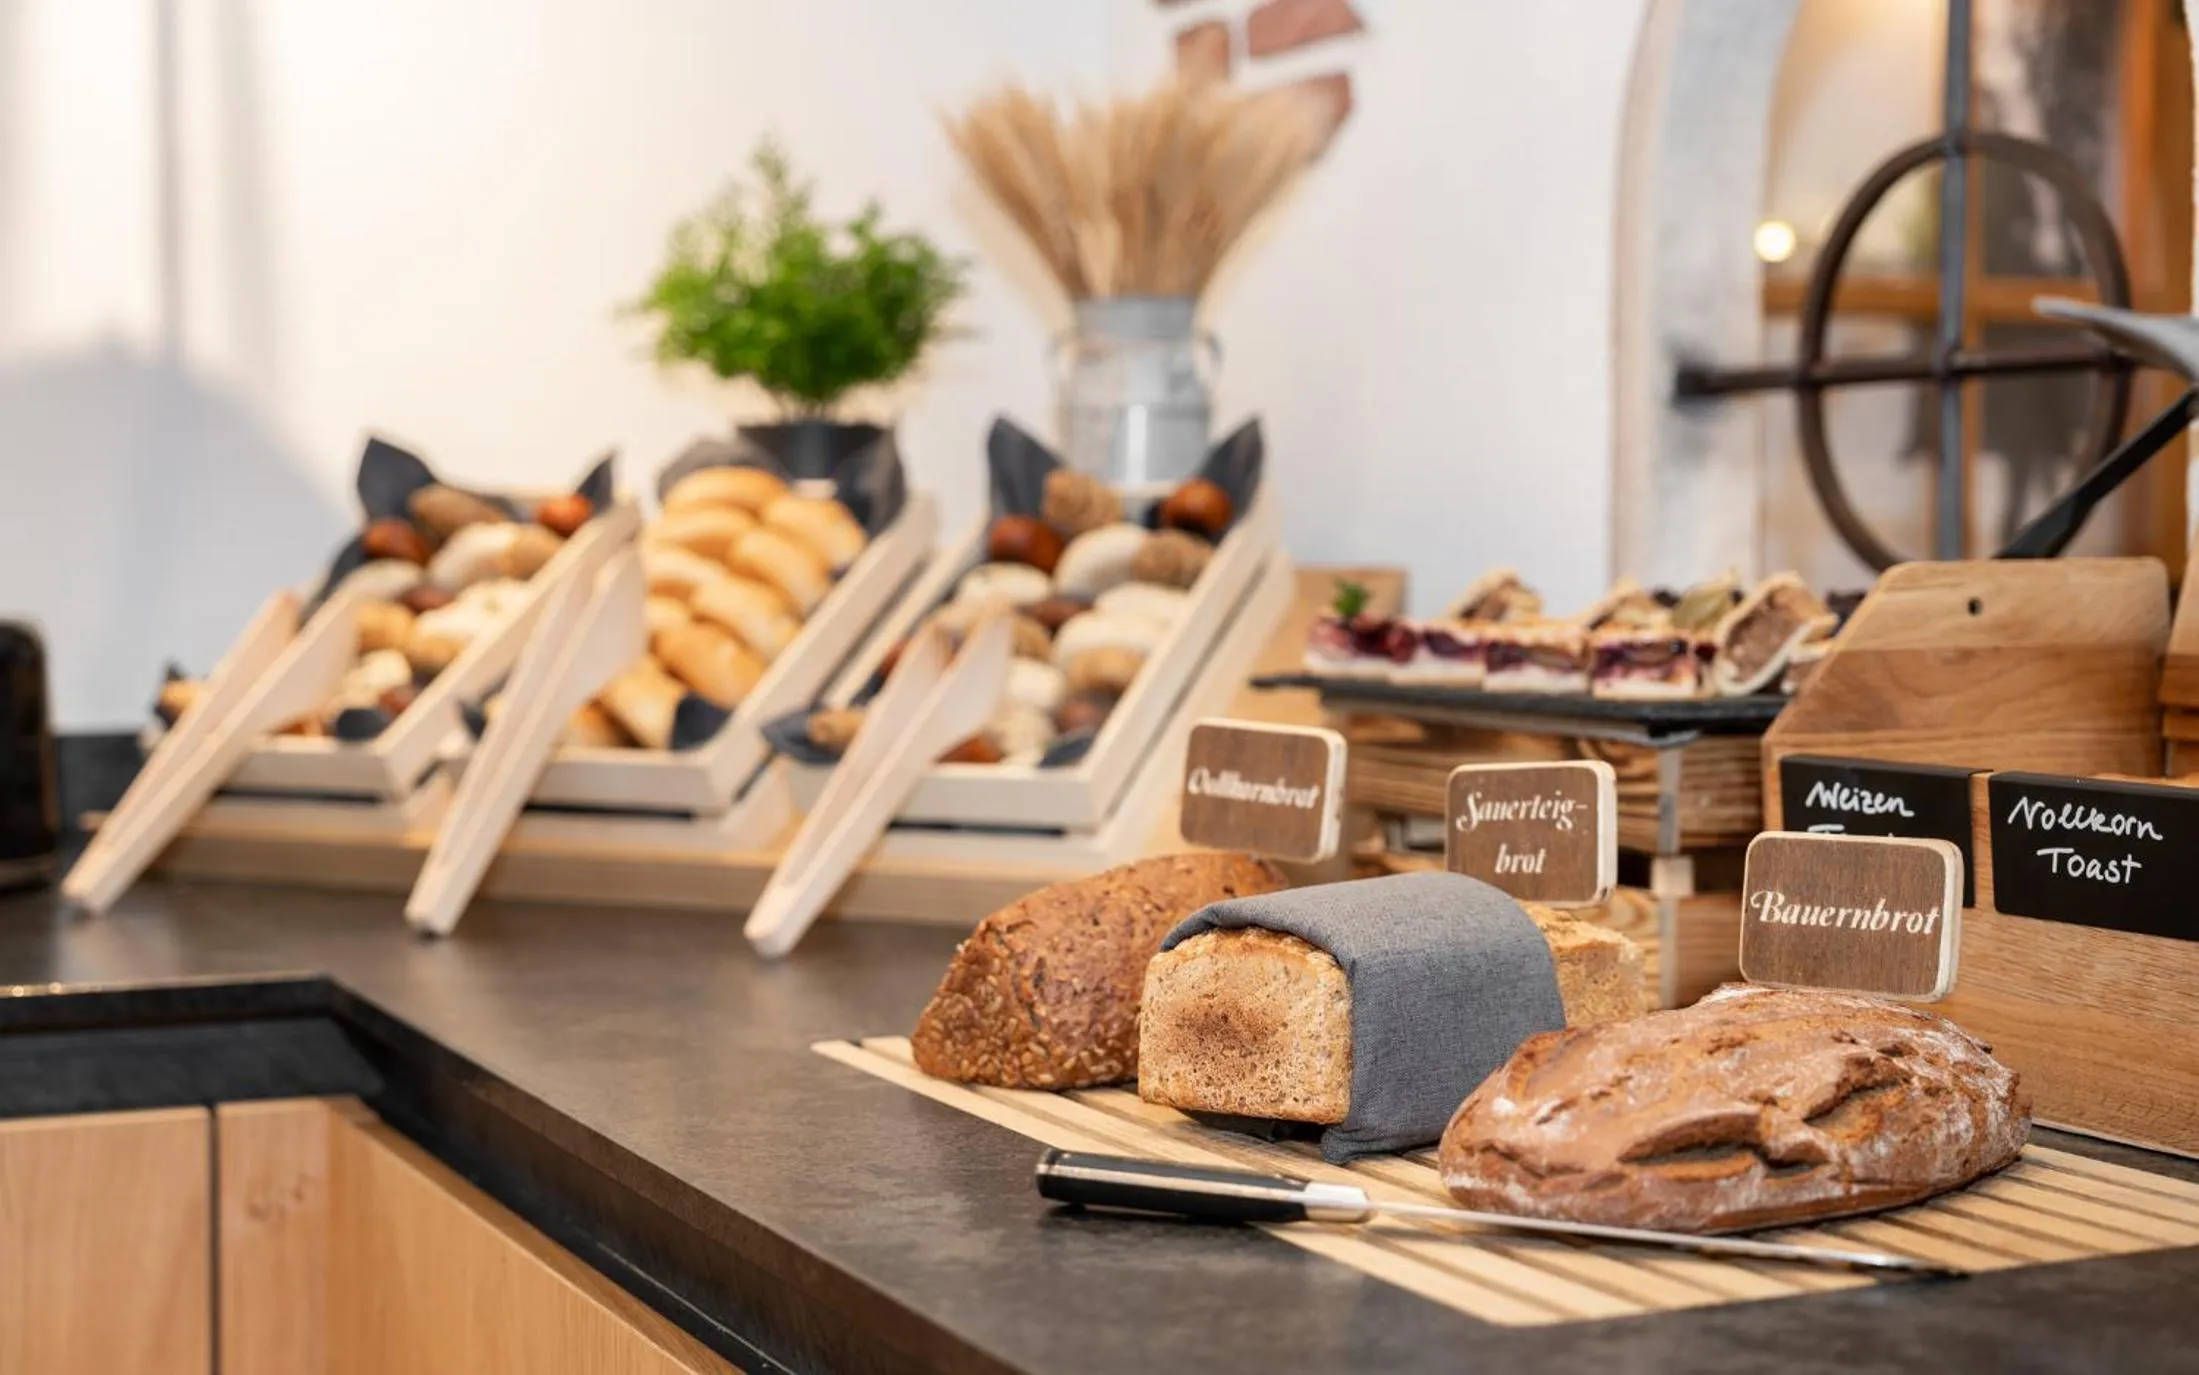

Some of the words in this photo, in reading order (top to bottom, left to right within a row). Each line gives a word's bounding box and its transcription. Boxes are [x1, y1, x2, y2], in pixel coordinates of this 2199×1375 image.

[1456, 789, 1588, 831] Sauerteig-
[1804, 780, 1915, 818] Weizen
[2006, 796, 2164, 841] Vollkorn
[1494, 843, 1547, 874] brot
[2037, 847, 2142, 884] Toast
[1750, 890, 1940, 935] Bauernbrot
